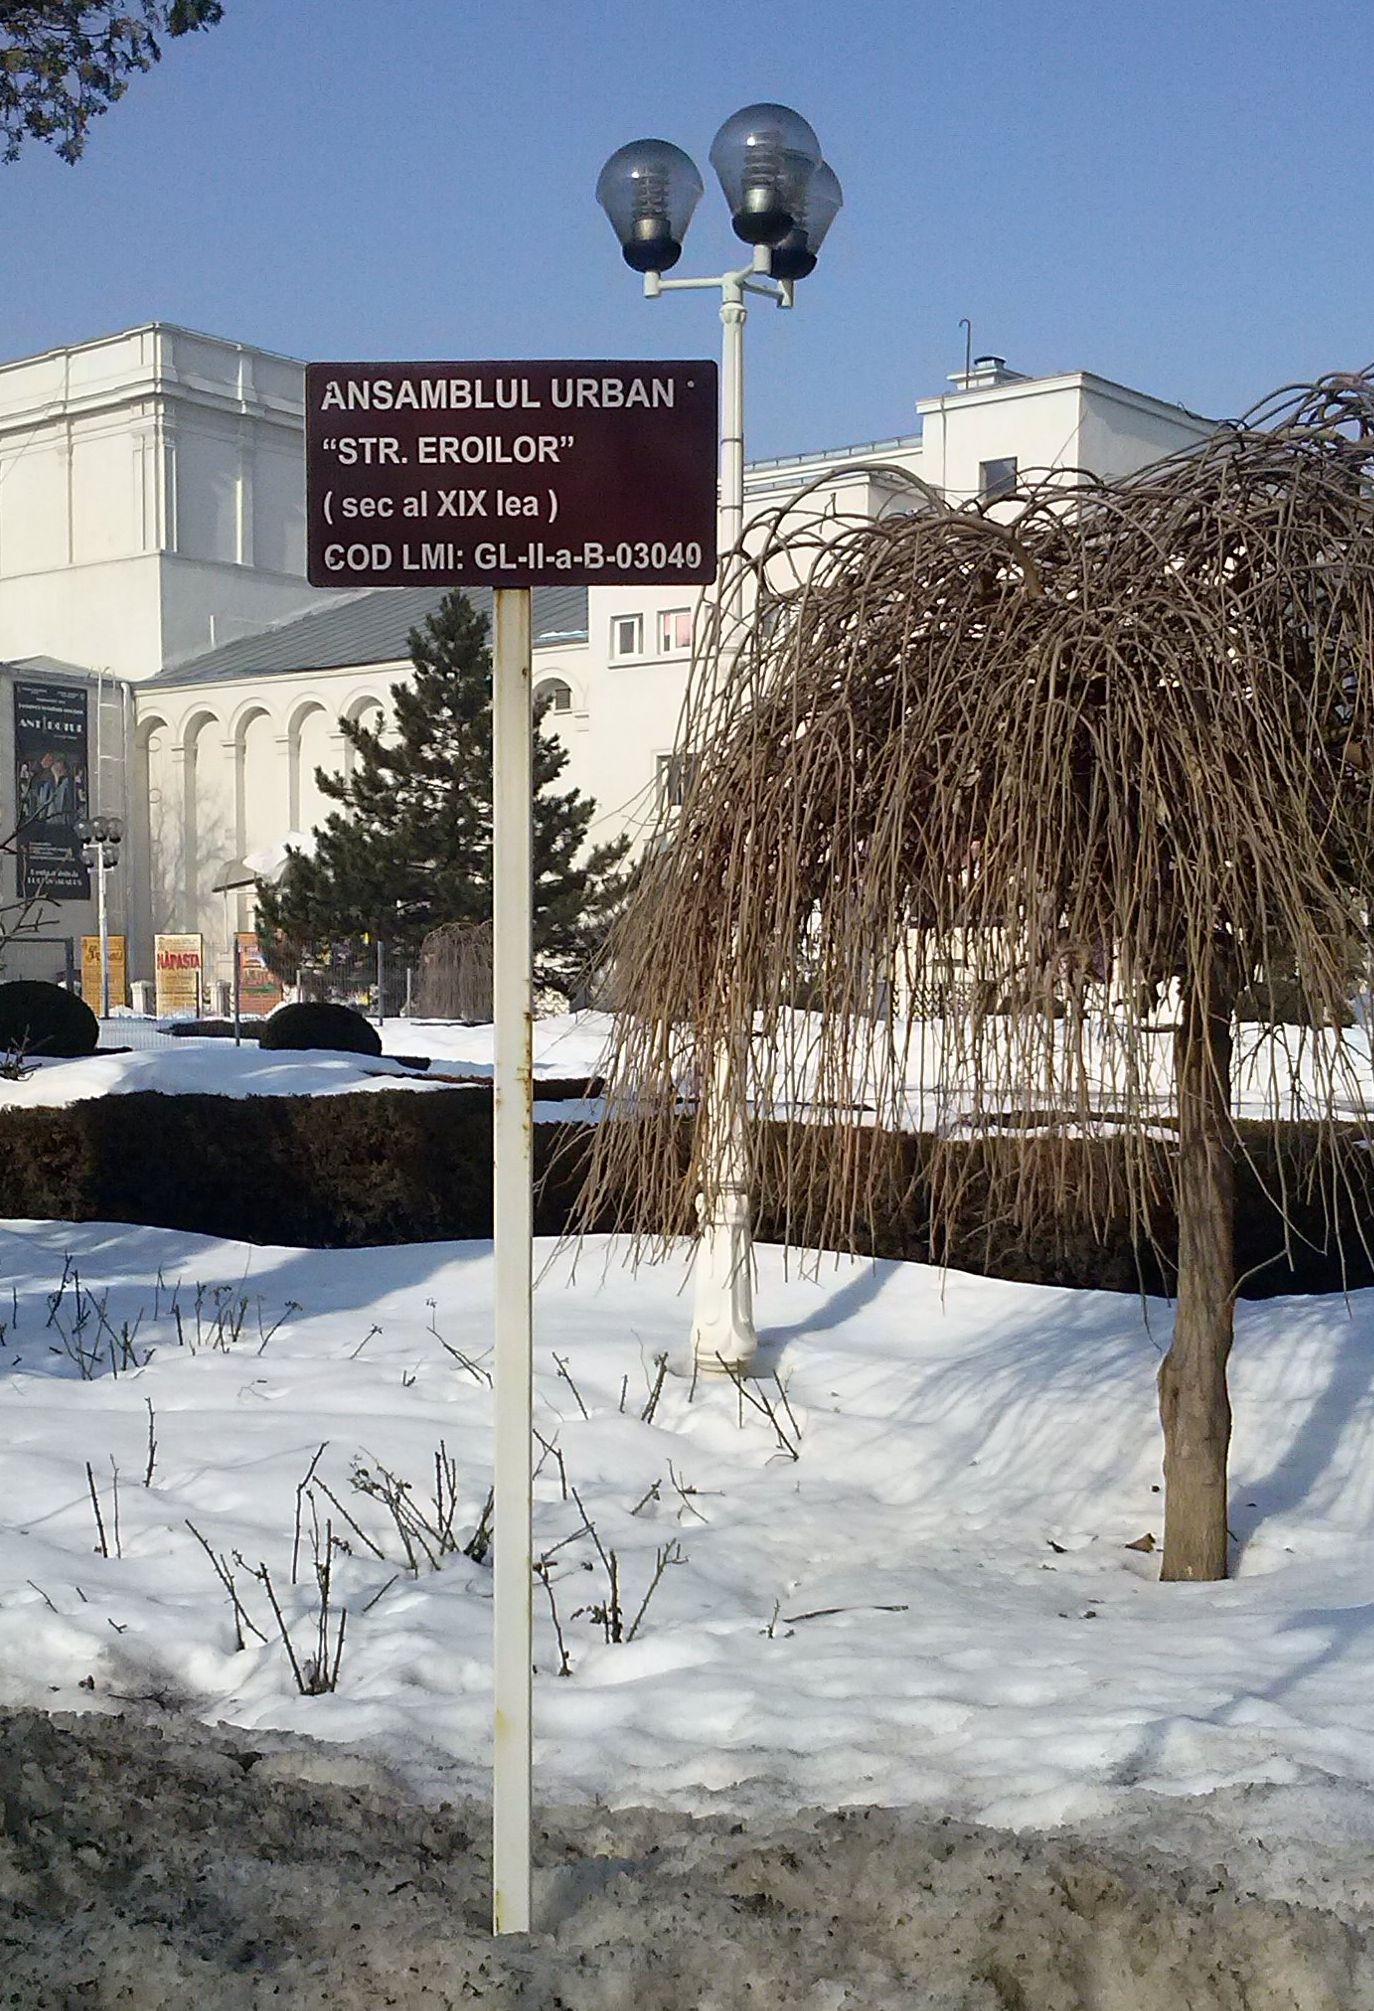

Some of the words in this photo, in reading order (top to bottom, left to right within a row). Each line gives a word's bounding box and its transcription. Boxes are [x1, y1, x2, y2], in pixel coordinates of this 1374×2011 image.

[321, 379, 541, 410] ANSAMBLUL
[552, 378, 674, 408] URBAN
[323, 437, 408, 464] “STR.
[418, 435, 574, 464] EROILOR”
[342, 497, 393, 518] sec
[403, 490, 428, 517] al
[437, 489, 488, 517] XIX
[324, 543, 392, 571] COD
[403, 543, 464, 570] LMI:
[474, 542, 702, 571] GL-II-a-B-03040
